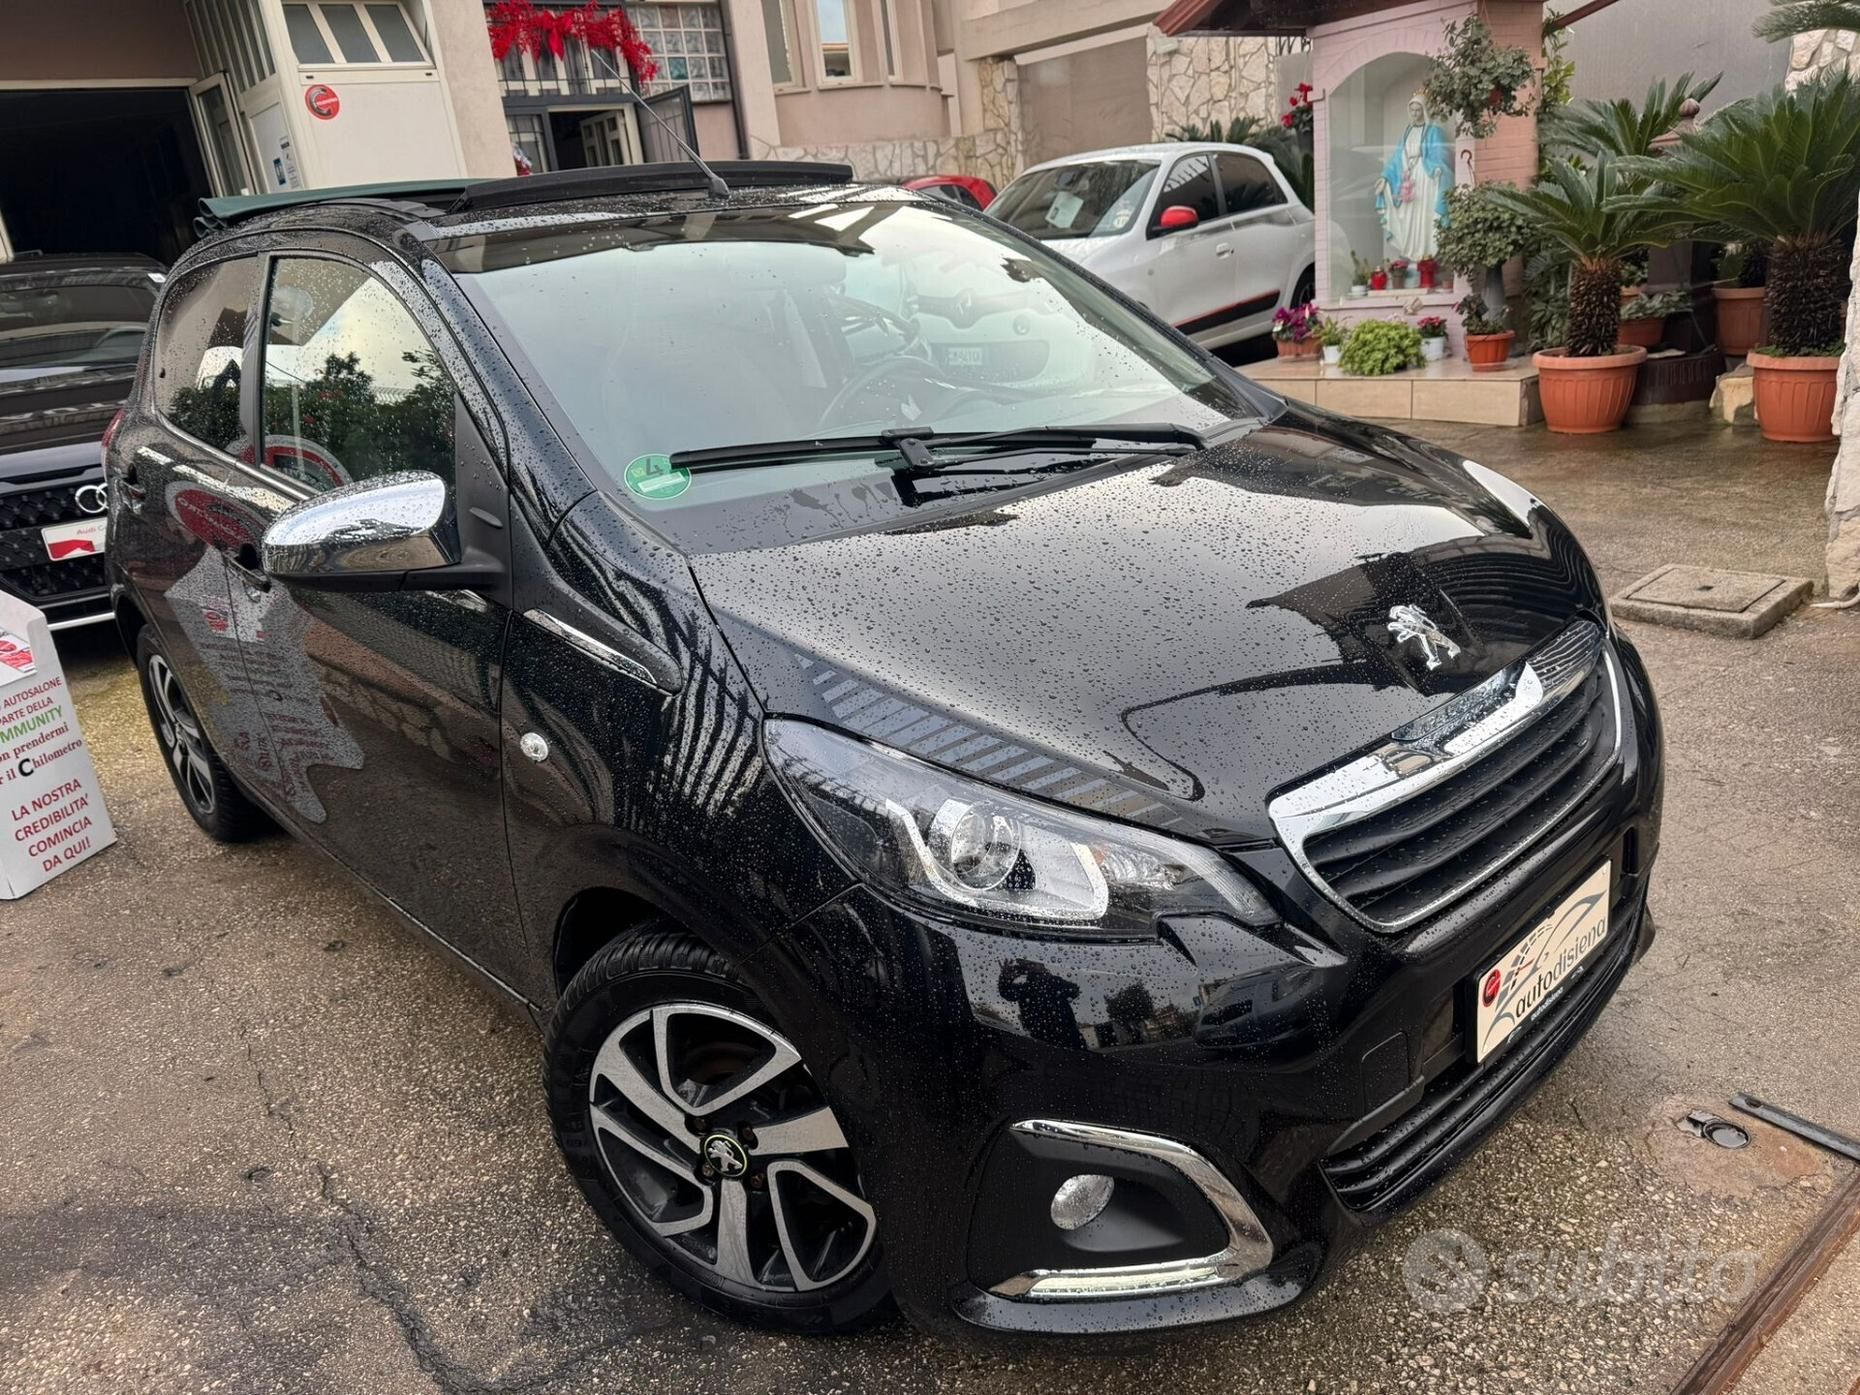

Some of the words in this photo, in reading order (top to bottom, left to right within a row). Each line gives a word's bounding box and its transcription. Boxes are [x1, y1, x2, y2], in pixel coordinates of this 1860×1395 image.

[3, 676, 63, 709] AUTOSALONE
[26, 696, 54, 715] DELLA
[5, 768, 17, 781] il
[18, 739, 83, 777] Chilometro
[13, 721, 70, 759] prendermi
[11, 805, 31, 821] LA
[31, 778, 82, 812] NOSTRA
[15, 793, 89, 842] CREDIBILITA'
[28, 816, 93, 857] COMINCIA
[42, 854, 63, 872] DA
[63, 836, 91, 860] QUI!
[1515, 917, 1606, 1018] autodisiena
